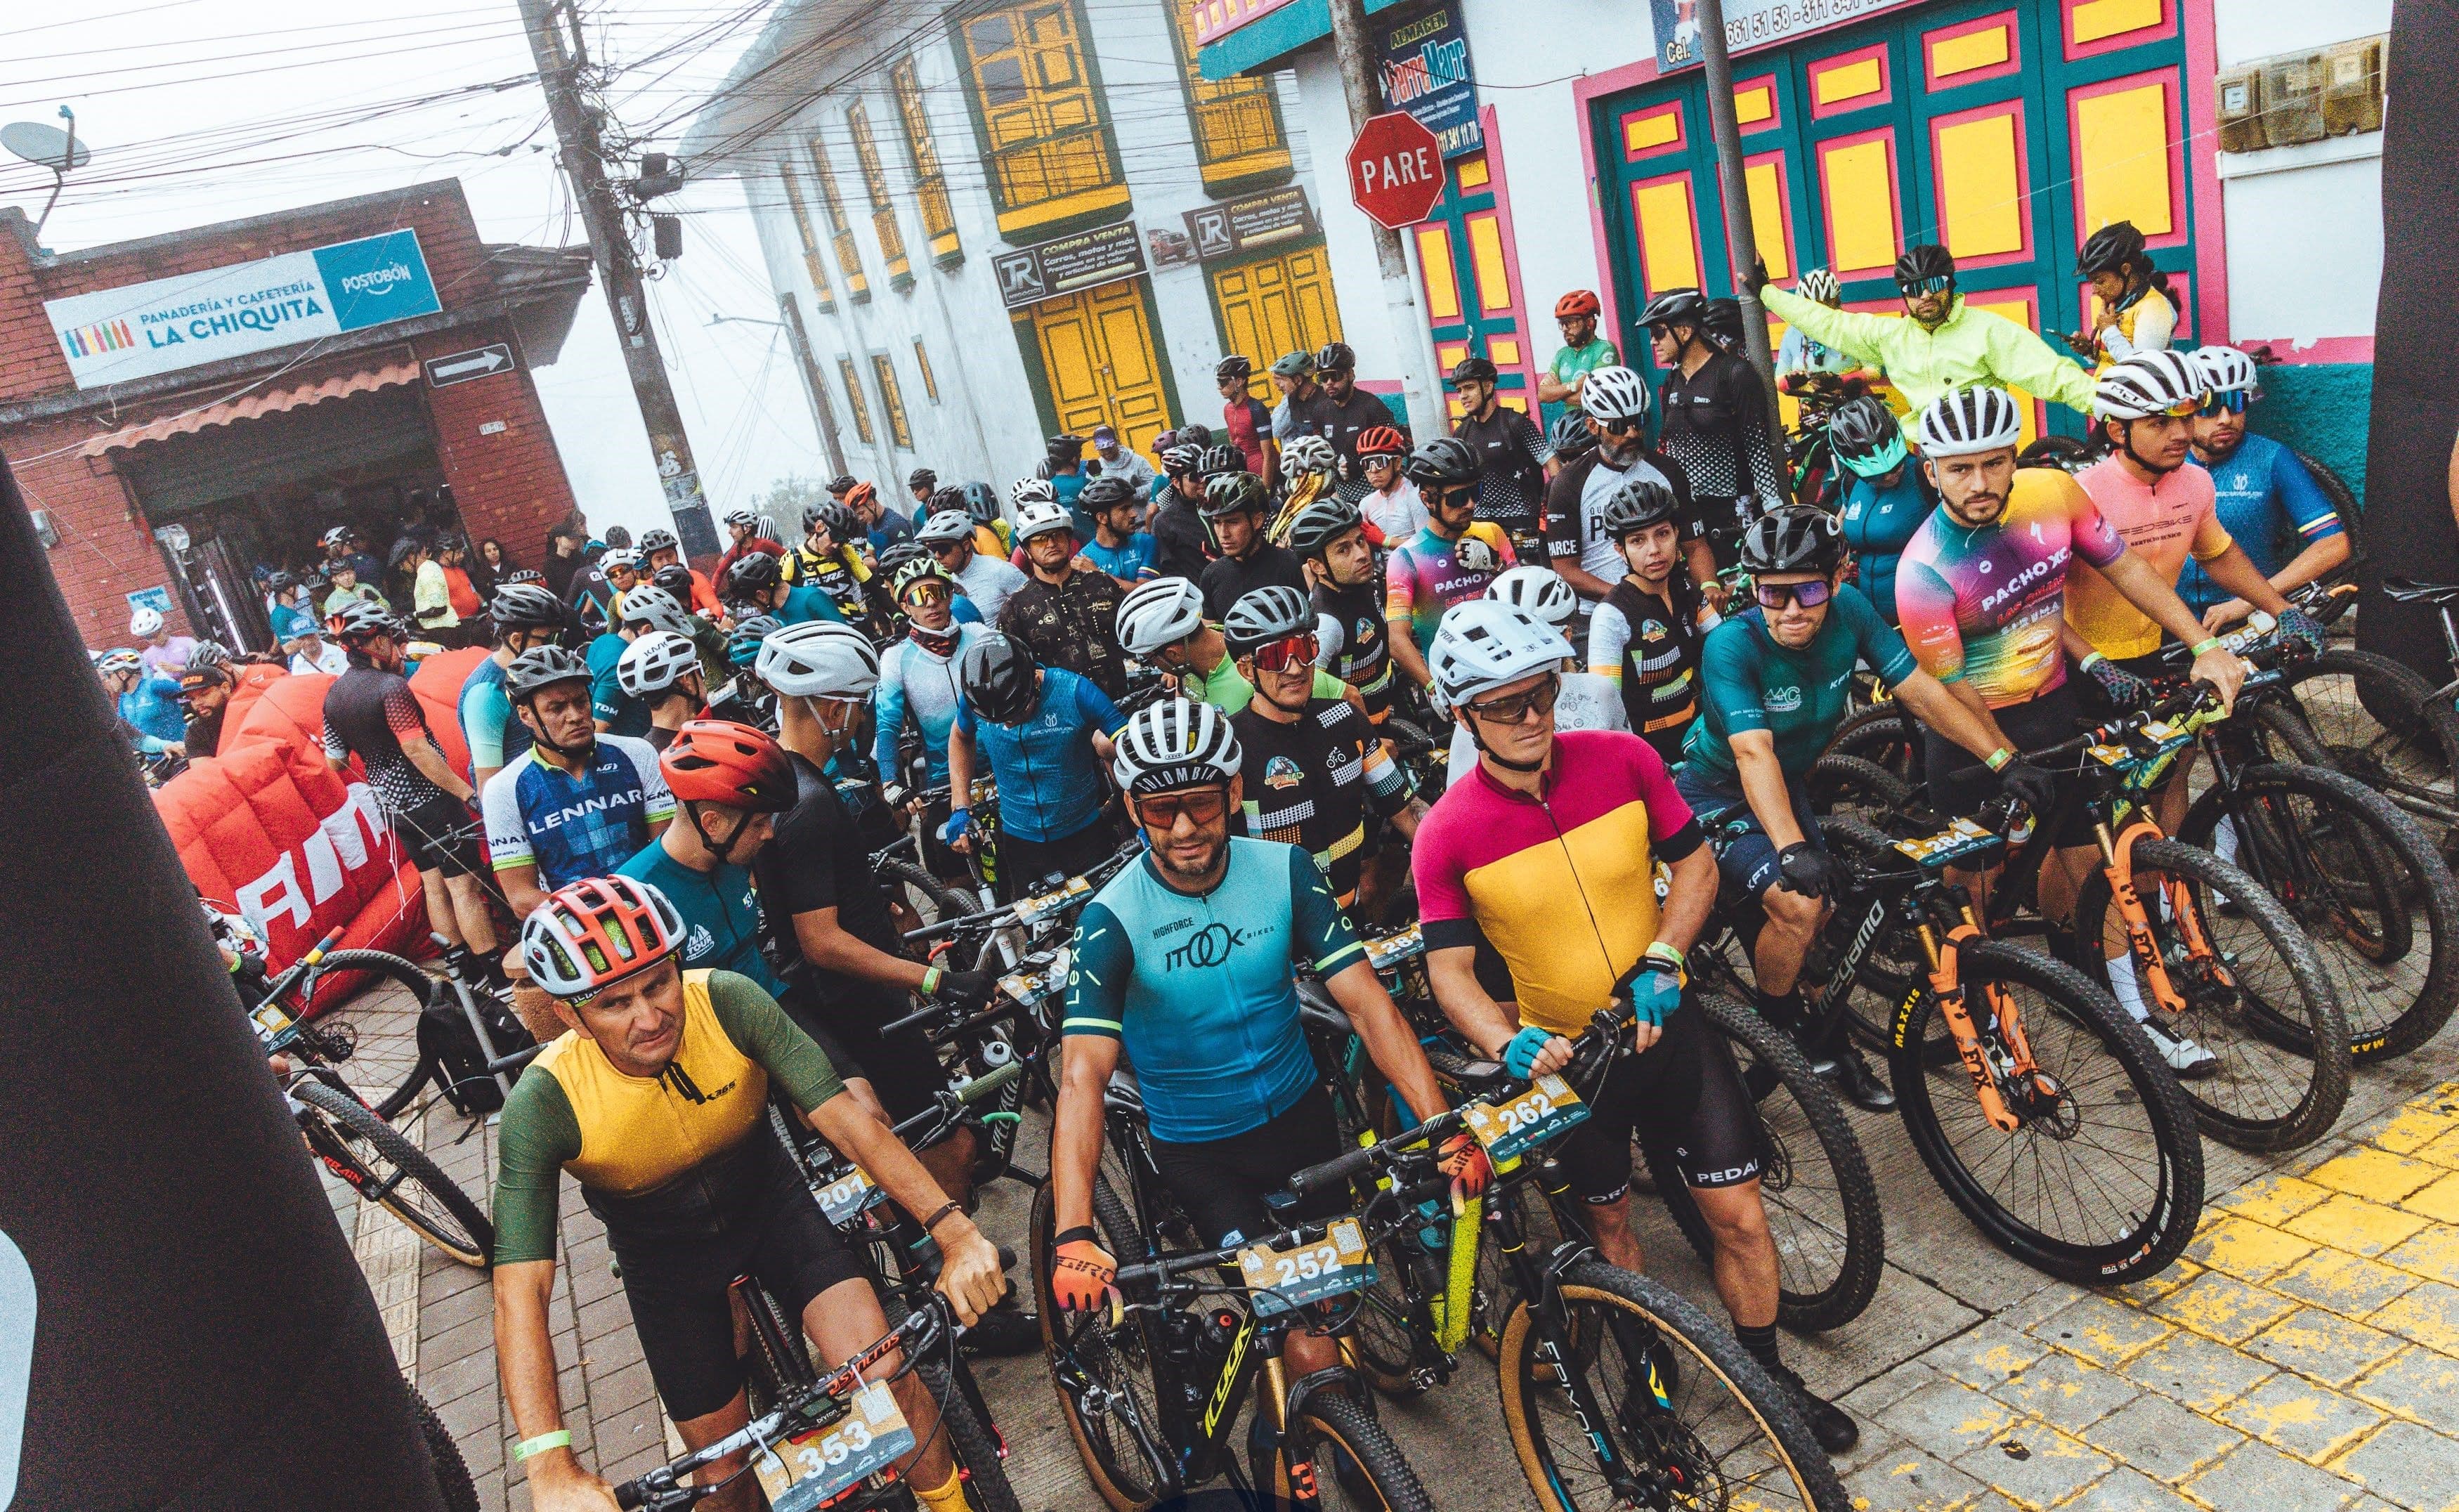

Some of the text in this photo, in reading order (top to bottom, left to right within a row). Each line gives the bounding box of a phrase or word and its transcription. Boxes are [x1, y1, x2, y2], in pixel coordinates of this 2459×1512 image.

[1752, 13, 1769, 38] 51
[1773, 8, 1791, 35] 58
[1361, 147, 1433, 193] PARE
[1042, 226, 1131, 255] COMPRA VENTA
[1078, 245, 1106, 257] motos
[1108, 242, 1114, 252] y
[341, 263, 413, 294] POSTOBÓN
[141, 281, 315, 325] PANADERÍA Y CAFETERÍA
[147, 296, 324, 348] LA CHIQUITA
[1435, 573, 1482, 593] PACHO
[1981, 560, 2047, 611] PACHO
[644, 641, 668, 657] KASK
[595, 702, 619, 716] TDM
[1136, 767, 1218, 793] COLOMBIA
[528, 790, 644, 835] LENNAR
[1926, 832, 1972, 853] 284
[1034, 889, 1071, 911] 301
[1152, 917, 1194, 939] HIGHFORCE
[1247, 926, 1274, 939] BIKES
[1381, 931, 1423, 954] 281
[688, 935, 712, 955] TOUR
[2132, 931, 2161, 969] FOX
[1026, 965, 1068, 990] 330
[1067, 926, 1083, 1004] Lexa
[1895, 989, 1920, 1048] MAXXIS
[1962, 1048, 1992, 1092] FOX
[1498, 1093, 1557, 1135] 262
[816, 1174, 868, 1212] 201
[1057, 1256, 1116, 1284] GIRO
[1275, 1246, 1343, 1287] 252
[816, 1409, 837, 1423] bryton
[797, 1420, 873, 1480] 353
